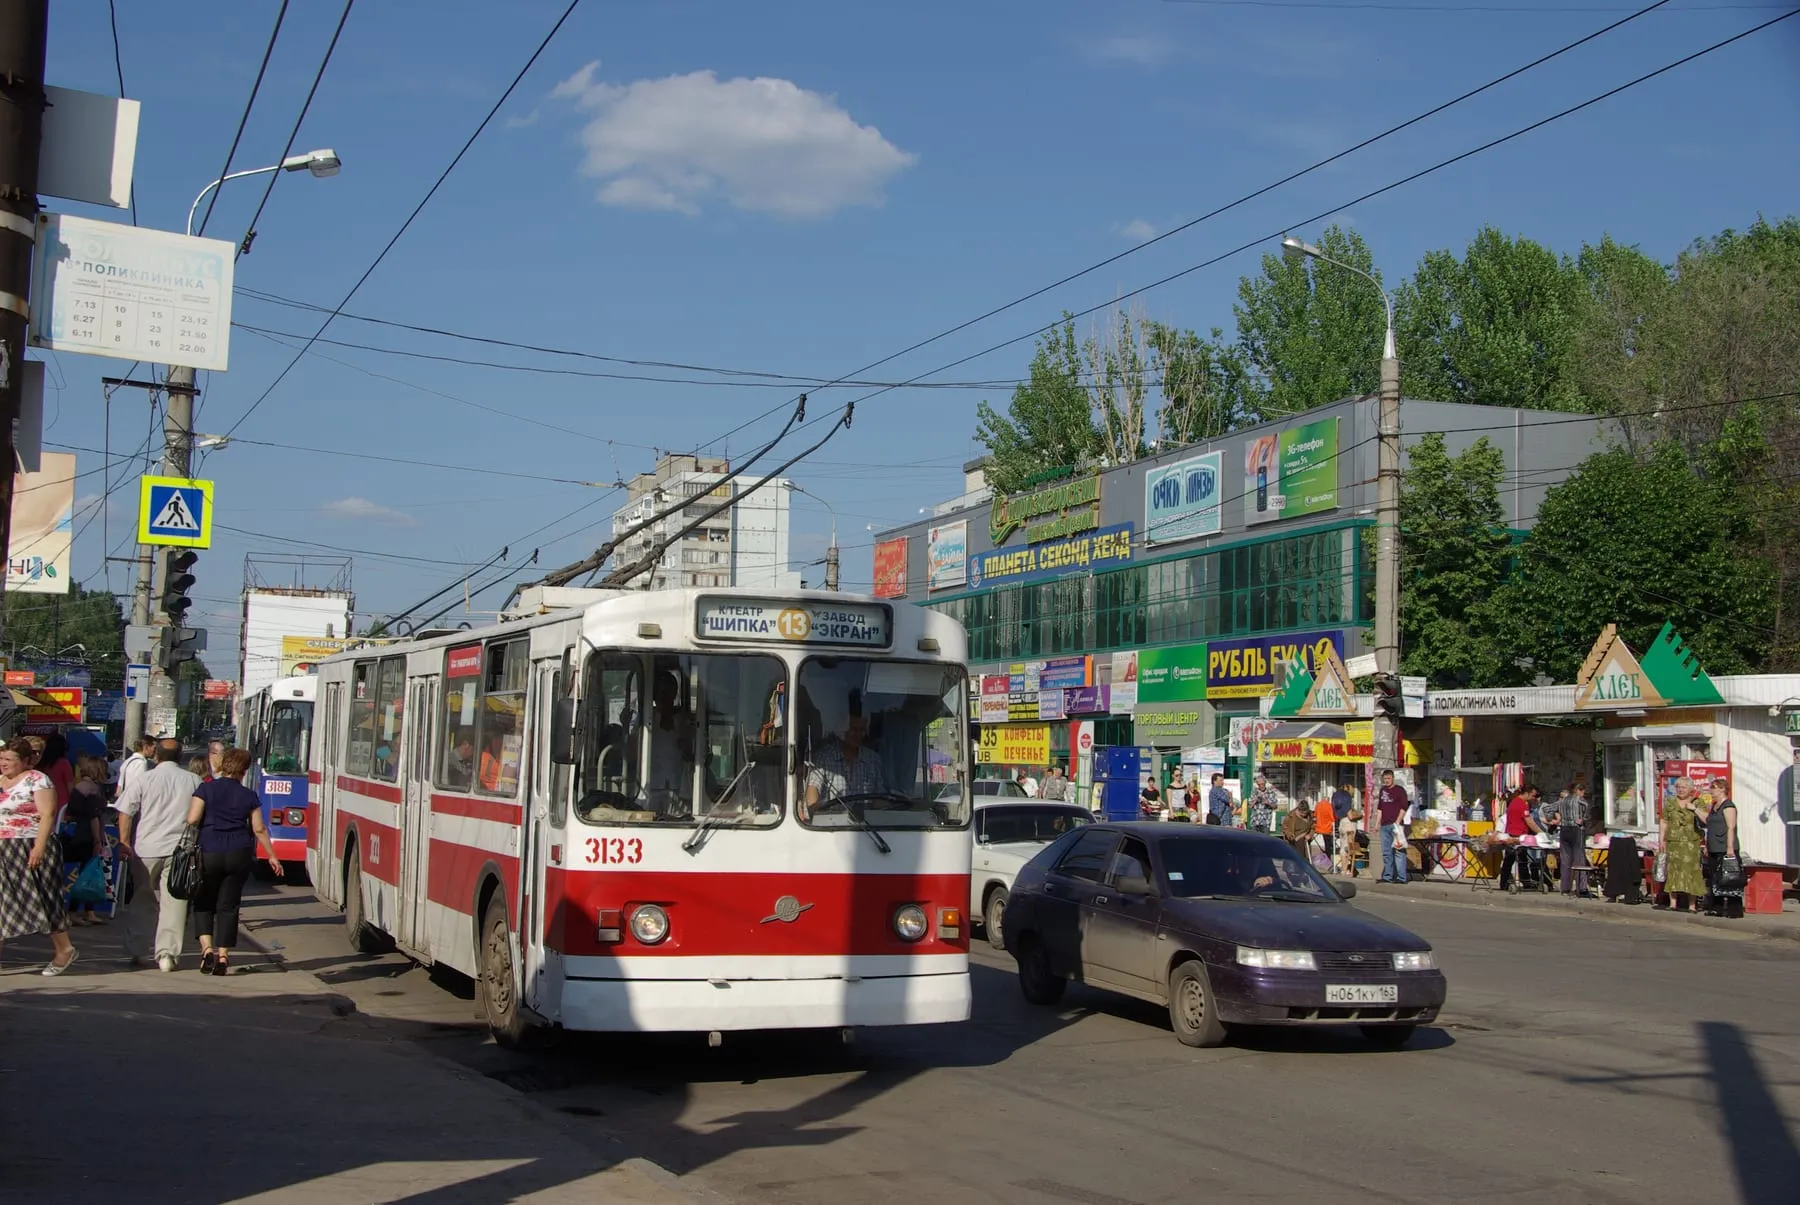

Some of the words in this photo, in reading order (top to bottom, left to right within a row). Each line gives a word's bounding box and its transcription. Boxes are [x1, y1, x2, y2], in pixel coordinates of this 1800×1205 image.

[75, 299, 96, 310] 7.13
[114, 304, 127, 314] 10
[73, 314, 96, 324] 6.27
[151, 310, 163, 319] 15
[115, 319, 122, 328] 8
[72, 329, 93, 339] 6.11
[114, 334, 121, 343] 8
[1153, 478, 1180, 510] ОЧКИ
[1185, 470, 1215, 505] ЛИНЗЫ
[984, 549, 1036, 579] ПЛАНЕТА
[1039, 538, 1089, 570] СЕКОНД
[1092, 530, 1130, 561] ХЕНД
[719, 605, 763, 617] К/ТЕАТР
[822, 611, 866, 625] ЗАВОД
[702, 616, 776, 634] “ШИПКА”
[781, 612, 806, 635] 13
[811, 622, 880, 640] “ЭКРАН”
[1209, 647, 1267, 679] РУБЛЬ
[1594, 673, 1640, 700] ХЛЕБ
[1313, 688, 1342, 709] ХЛЕБ
[1435, 696, 1497, 710] ПОЛИКЛИНИКА
[1500, 695, 1516, 708] №6
[1136, 711, 1174, 726] ТОРГОВЫЙ
[1175, 711, 1199, 727] ЦЕНТР
[983, 726, 997, 747] 35
[1004, 727, 1044, 741] КОНФЕТЫ
[1004, 747, 1044, 761] ПЕЧЕНЬЕ
[267, 781, 291, 793] 3186
[585, 837, 643, 864] 3133
[1379, 986, 1395, 997] 163
